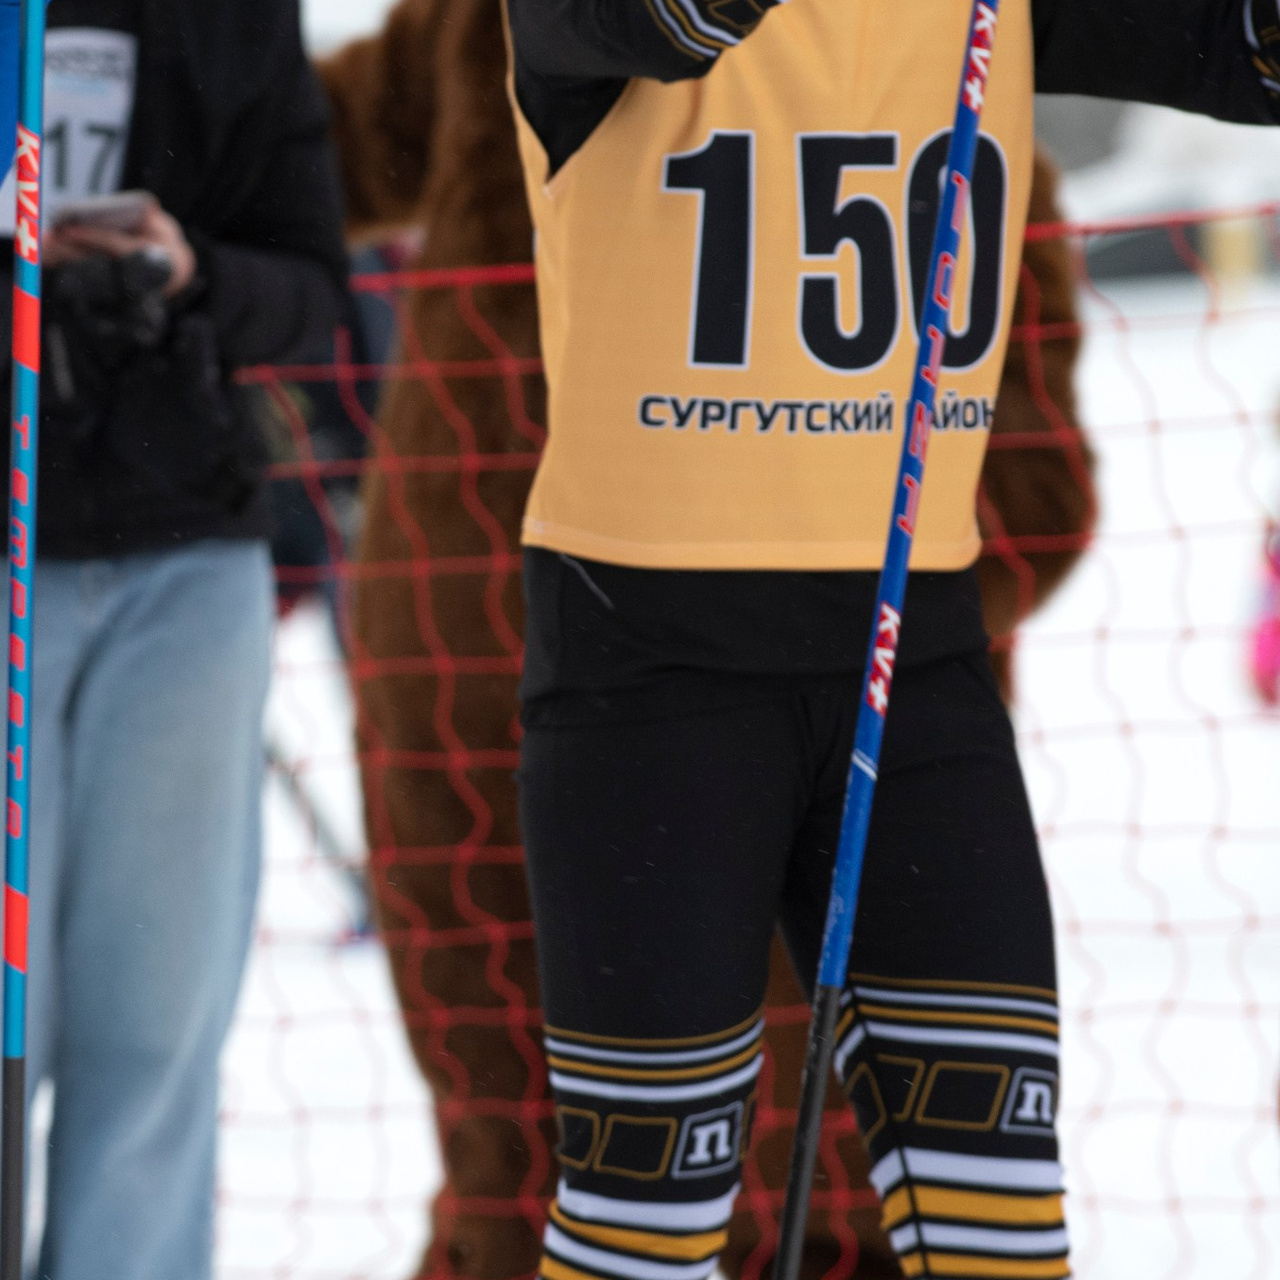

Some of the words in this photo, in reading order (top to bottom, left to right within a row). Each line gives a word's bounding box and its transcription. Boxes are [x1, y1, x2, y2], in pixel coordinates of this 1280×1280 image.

[16, 124, 40, 262] KV+
[661, 127, 1008, 375] 150
[640, 391, 894, 433] СУРГУТСКИЙ
[866, 601, 901, 718] KV+
